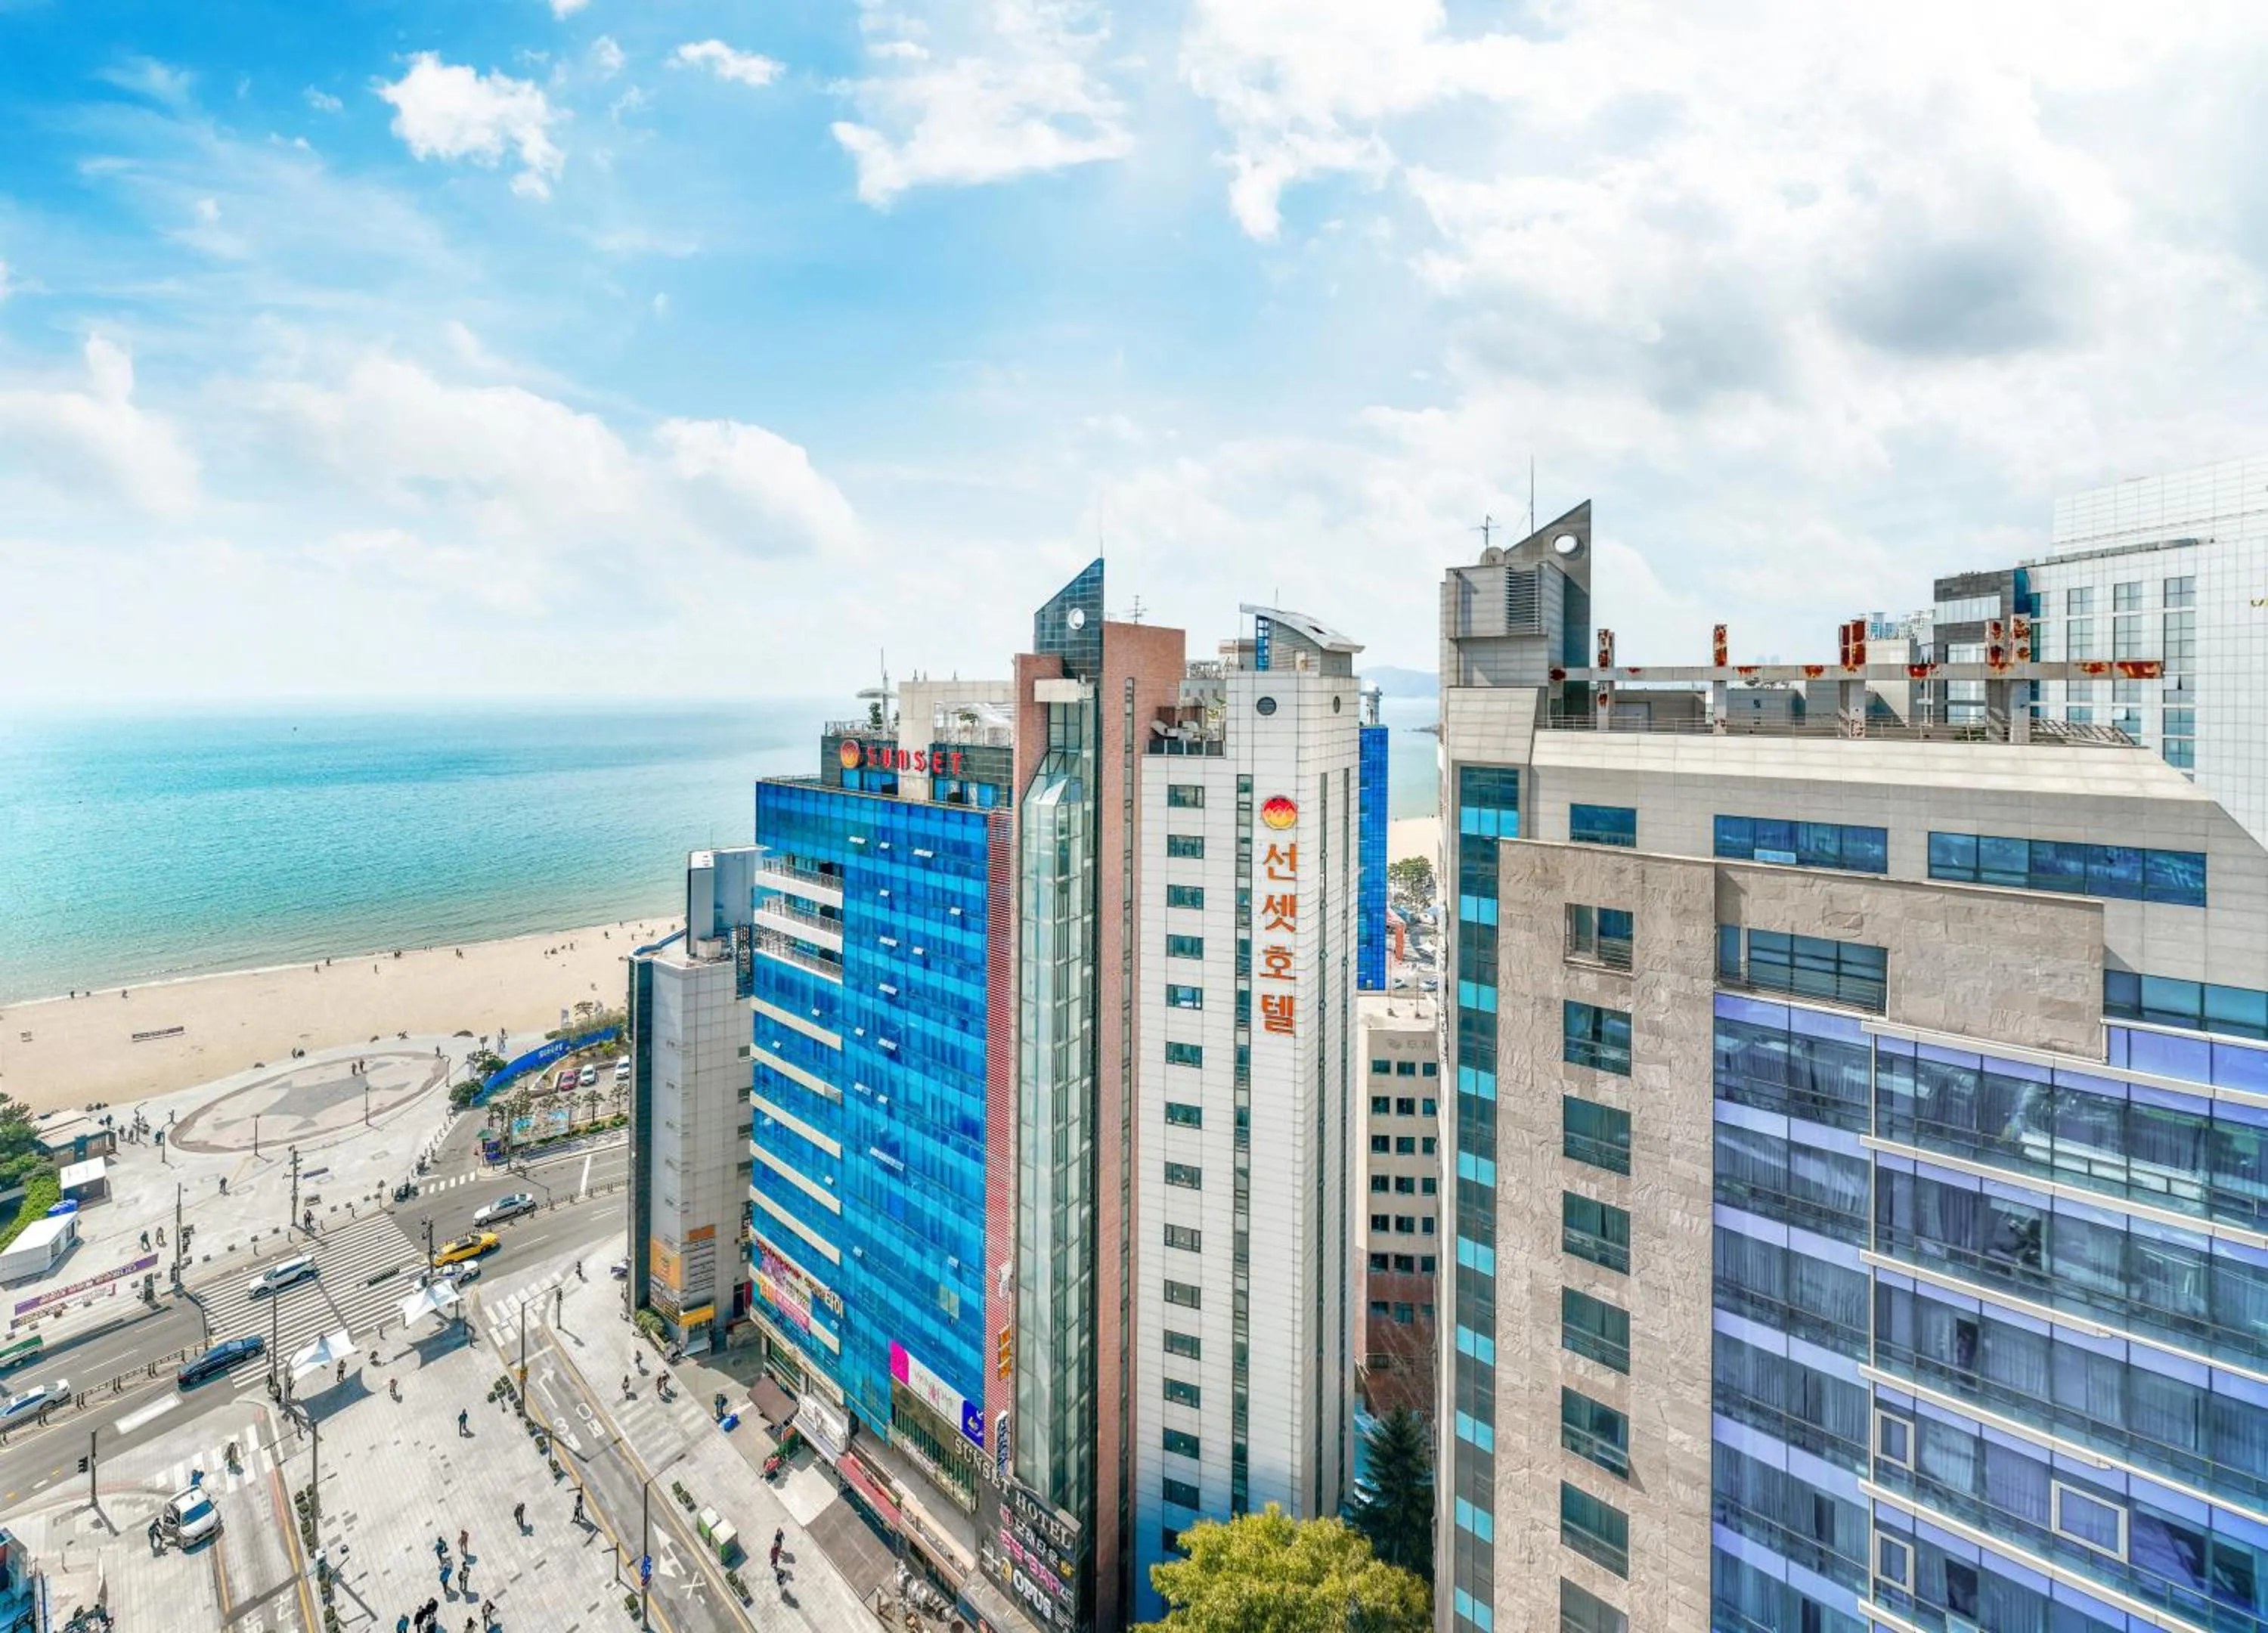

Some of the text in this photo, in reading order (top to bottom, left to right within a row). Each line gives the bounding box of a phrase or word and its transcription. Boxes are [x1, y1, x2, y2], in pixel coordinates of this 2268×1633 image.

[1259, 843, 1297, 1037] 선셋호텔
[1015, 1490, 1071, 1550] HOTEL
[1012, 1568, 1052, 1619] OPUS
